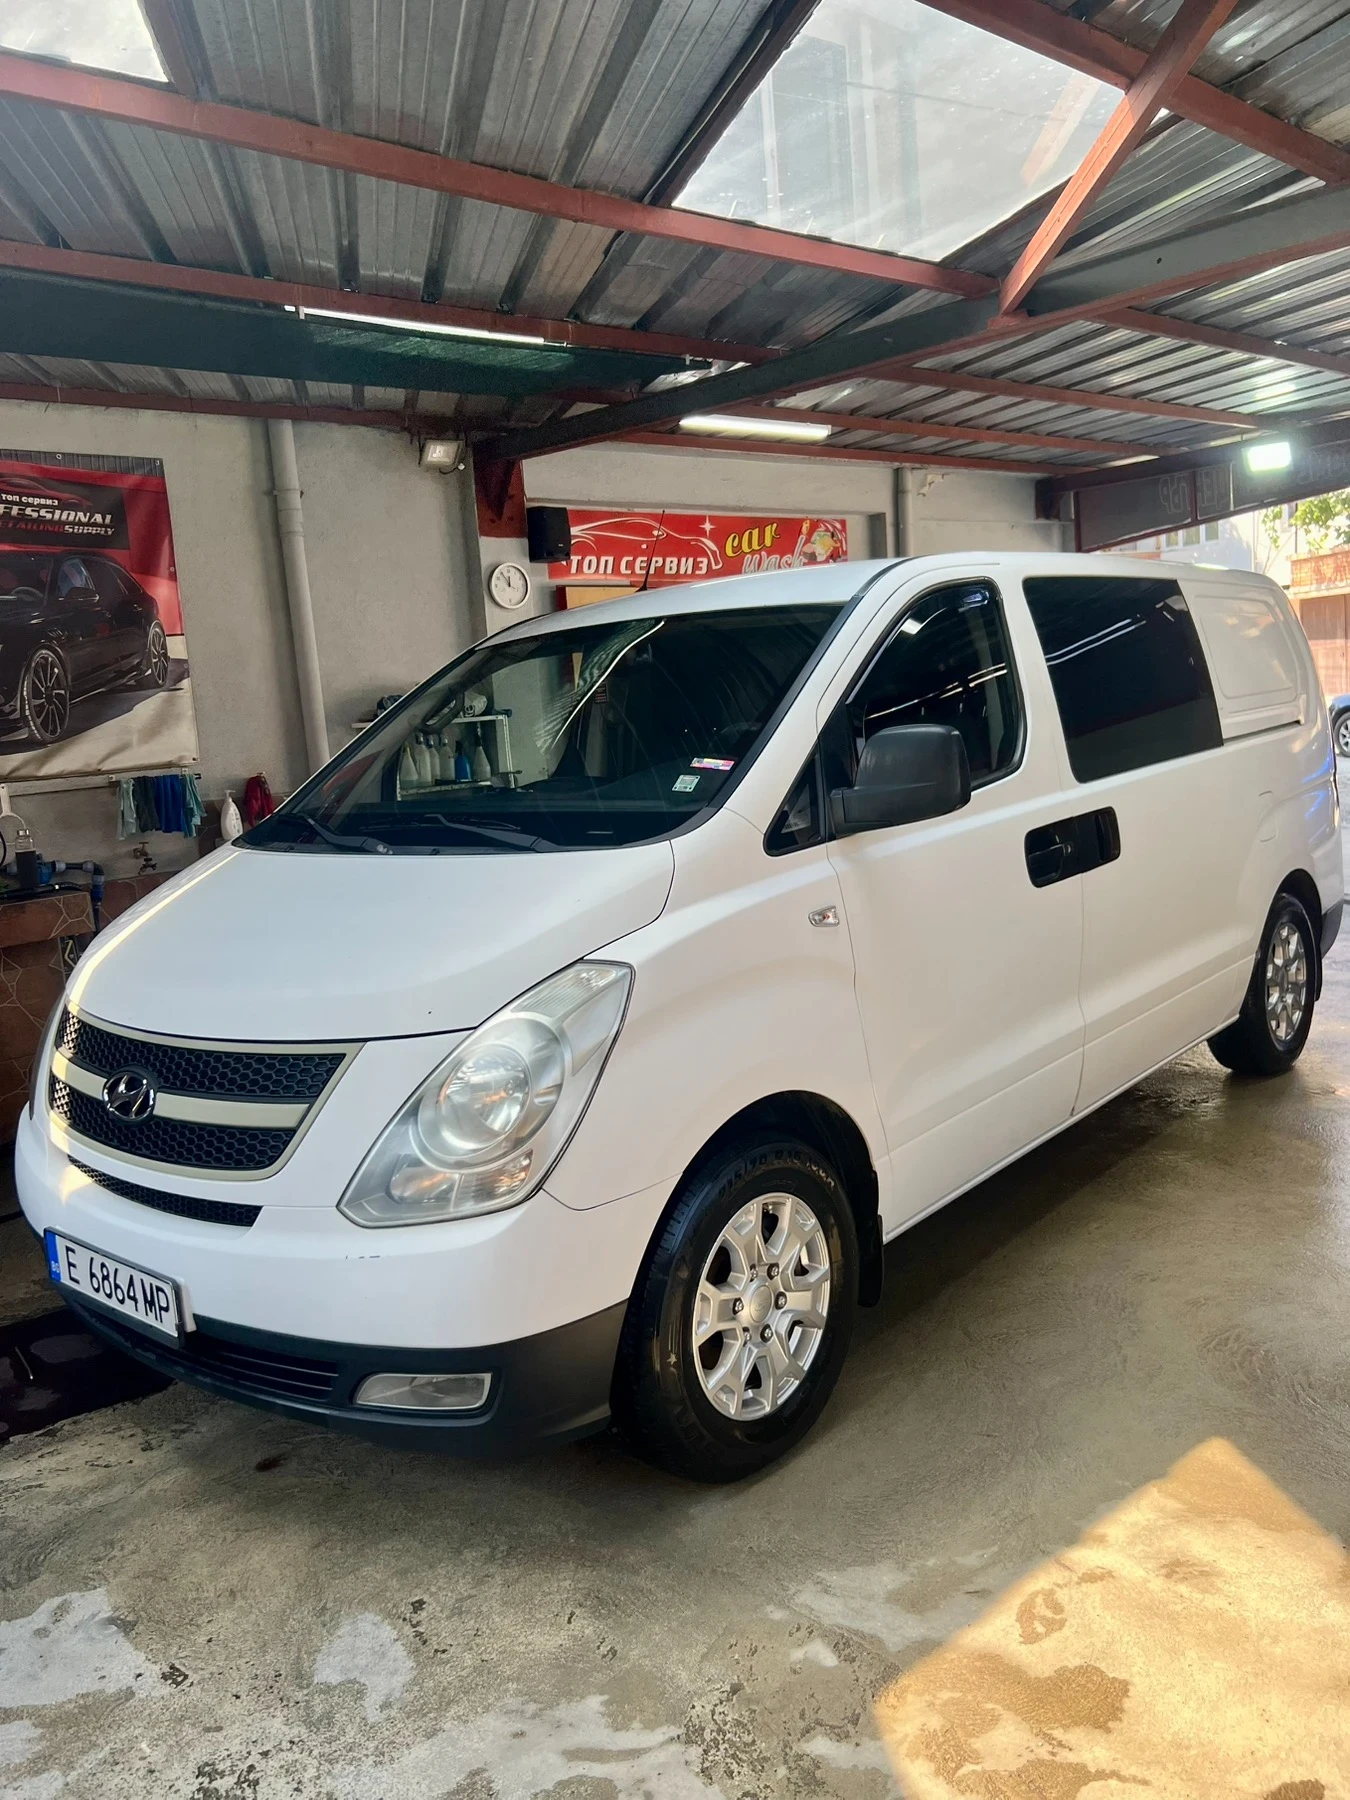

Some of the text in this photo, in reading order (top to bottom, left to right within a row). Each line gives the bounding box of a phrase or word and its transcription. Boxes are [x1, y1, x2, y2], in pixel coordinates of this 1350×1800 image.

[1, 493, 59, 506] топ сервиз
[64, 524, 115, 536] SUPPLY
[725, 523, 780, 557] car
[570, 555, 709, 575] ТОП СЕРВИЗ
[65, 1245, 80, 1285] E
[89, 1257, 138, 1312] 6864
